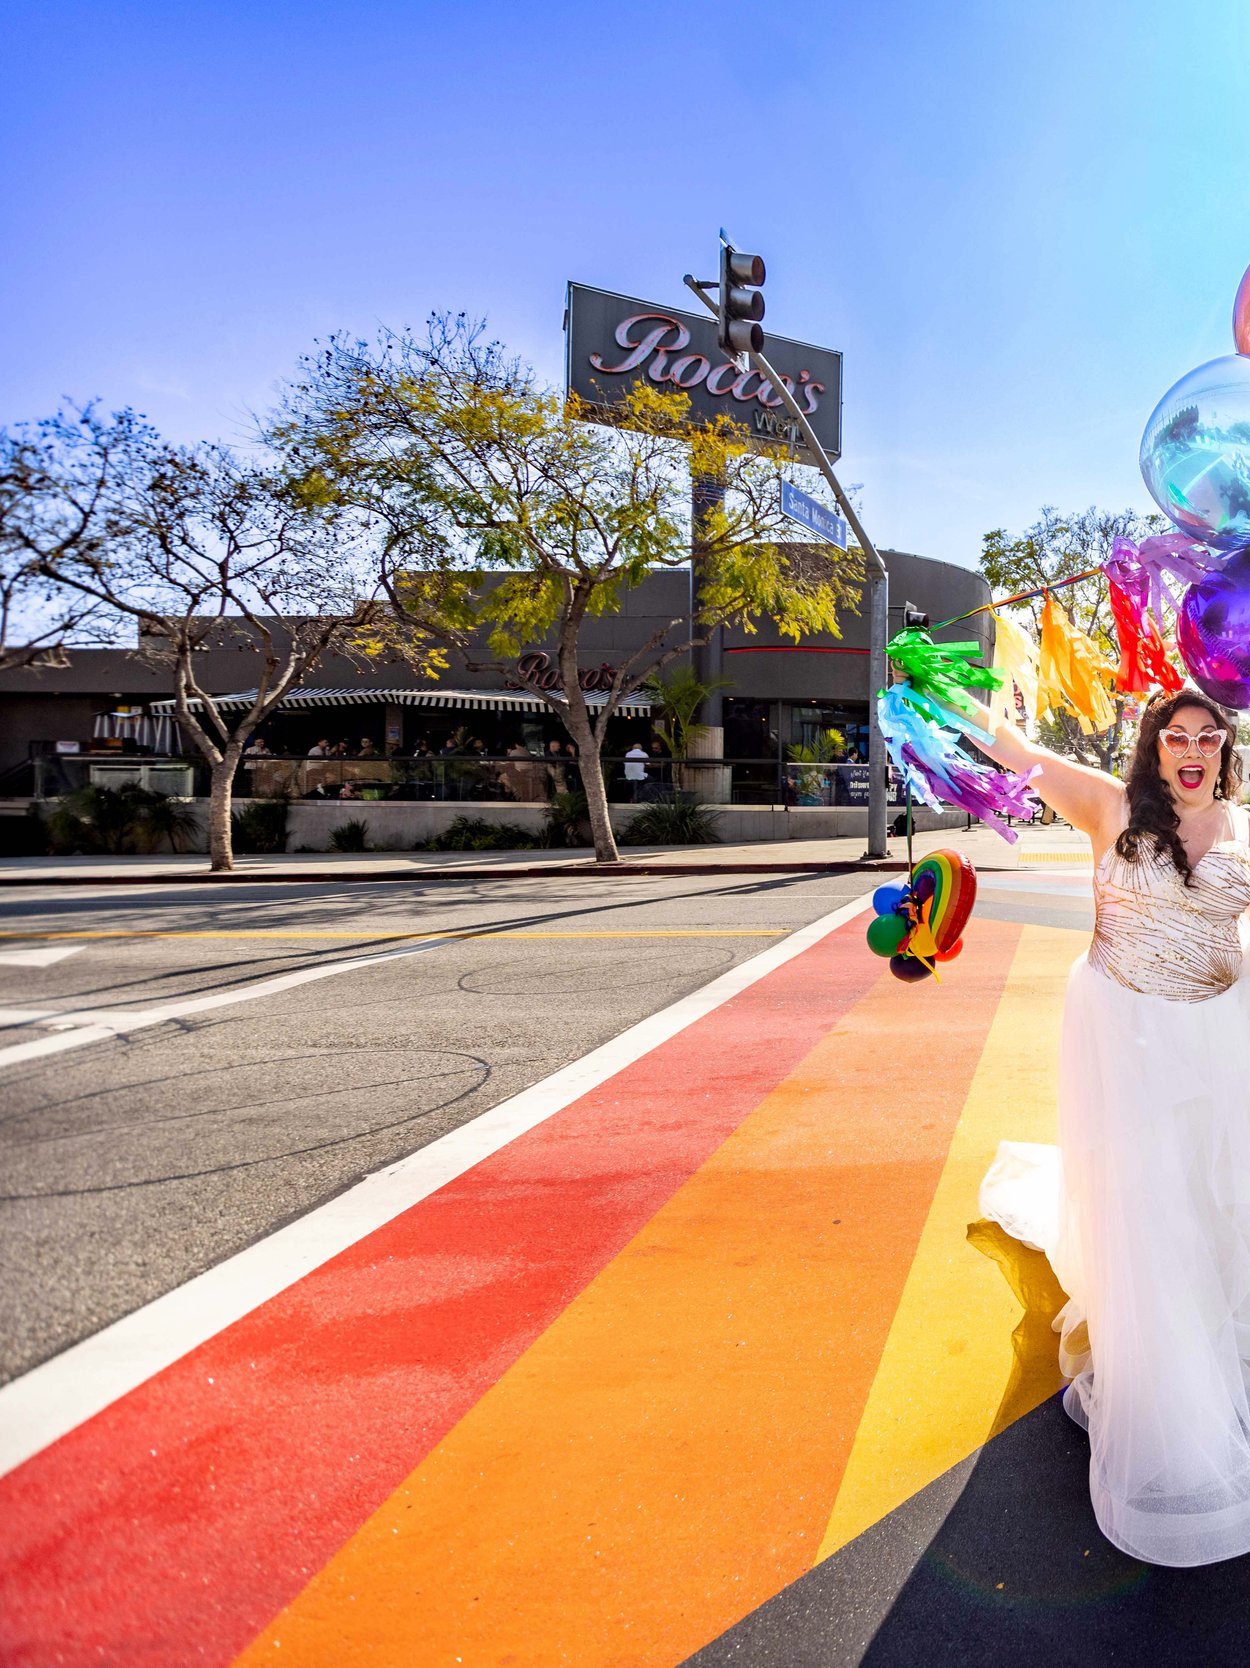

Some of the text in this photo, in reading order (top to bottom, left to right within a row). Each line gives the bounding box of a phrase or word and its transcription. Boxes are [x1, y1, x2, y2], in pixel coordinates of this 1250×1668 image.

[589, 312, 826, 415] Rocco's
[788, 492, 809, 519] Santa
[812, 507, 834, 535] Monica
